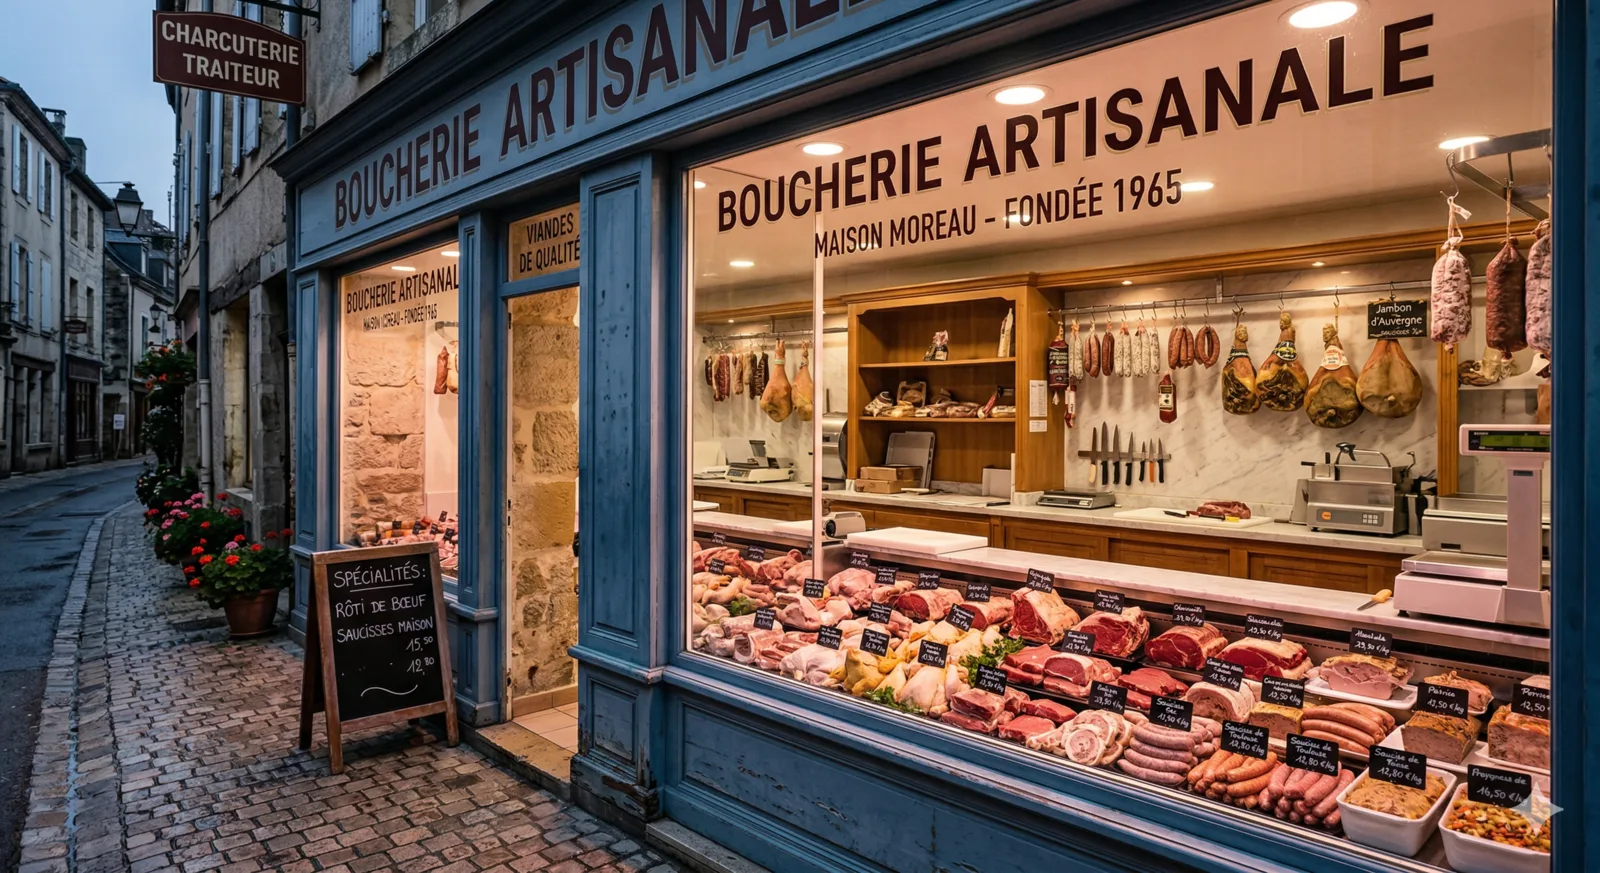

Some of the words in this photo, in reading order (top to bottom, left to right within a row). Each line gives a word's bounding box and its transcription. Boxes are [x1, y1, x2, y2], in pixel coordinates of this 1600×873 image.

[161, 20, 299, 65] CHARCUTERIE
[183, 52, 280, 89] TRAITEUR
[335, 103, 481, 230] BOUCHERIE
[500, 0, 884, 158] ARTISANA
[718, 136, 942, 233] BOUCHERIE
[963, 13, 1435, 183] ARTISANALE
[814, 222, 883, 259] MAISON
[889, 208, 976, 248] MOREAU
[1004, 176, 1103, 230] FONDÉE
[1113, 168, 1183, 212] 1965
[526, 212, 574, 245] VIANDES
[520, 251, 532, 273] DE
[536, 234, 580, 271] QUALITÉ
[346, 281, 397, 314] BOUCHERIE
[1376, 303, 1412, 314] Jambon
[1371, 316, 1423, 328] d'Auvergne
[371, 600, 387, 613] DE
[391, 594, 427, 611] BŒUF
[337, 623, 394, 643] SAUCISSES
[398, 616, 433, 633] MAISON
[1520, 700, 1546, 712] 12,50
[1254, 728, 1264, 737] de
[1295, 745, 1327, 759] Toulouse
[1322, 743, 1333, 752] de
[1408, 754, 1420, 764] de
[1377, 766, 1404, 778] 12,80
[1514, 776, 1527, 785] de
[1476, 786, 1506, 799] 16,50
